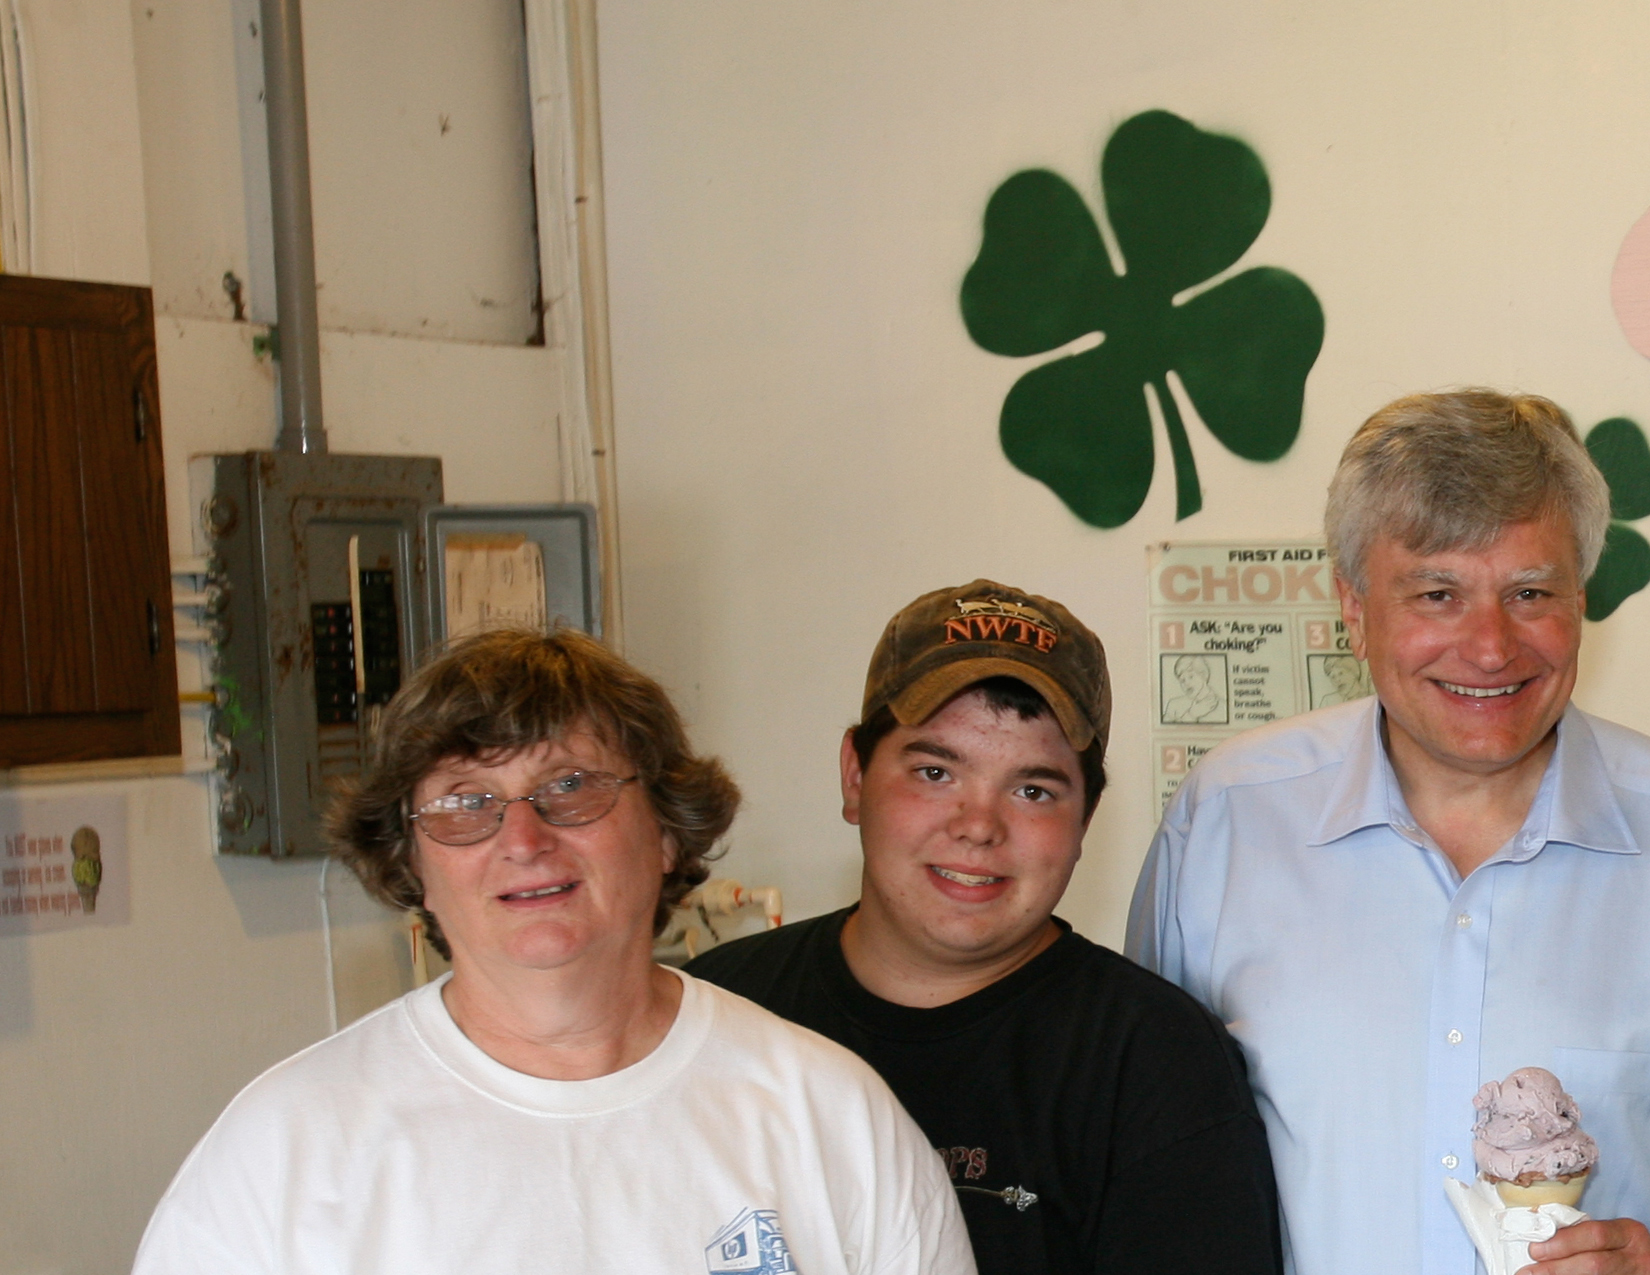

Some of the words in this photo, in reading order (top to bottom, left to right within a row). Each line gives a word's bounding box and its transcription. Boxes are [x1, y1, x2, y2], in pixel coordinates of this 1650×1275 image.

[1228, 549, 1277, 562] FIRST
[1282, 549, 1313, 561] AID
[945, 616, 1057, 654] NWTF
[1189, 620, 1221, 634] ASK:
[1259, 623, 1283, 636] you
